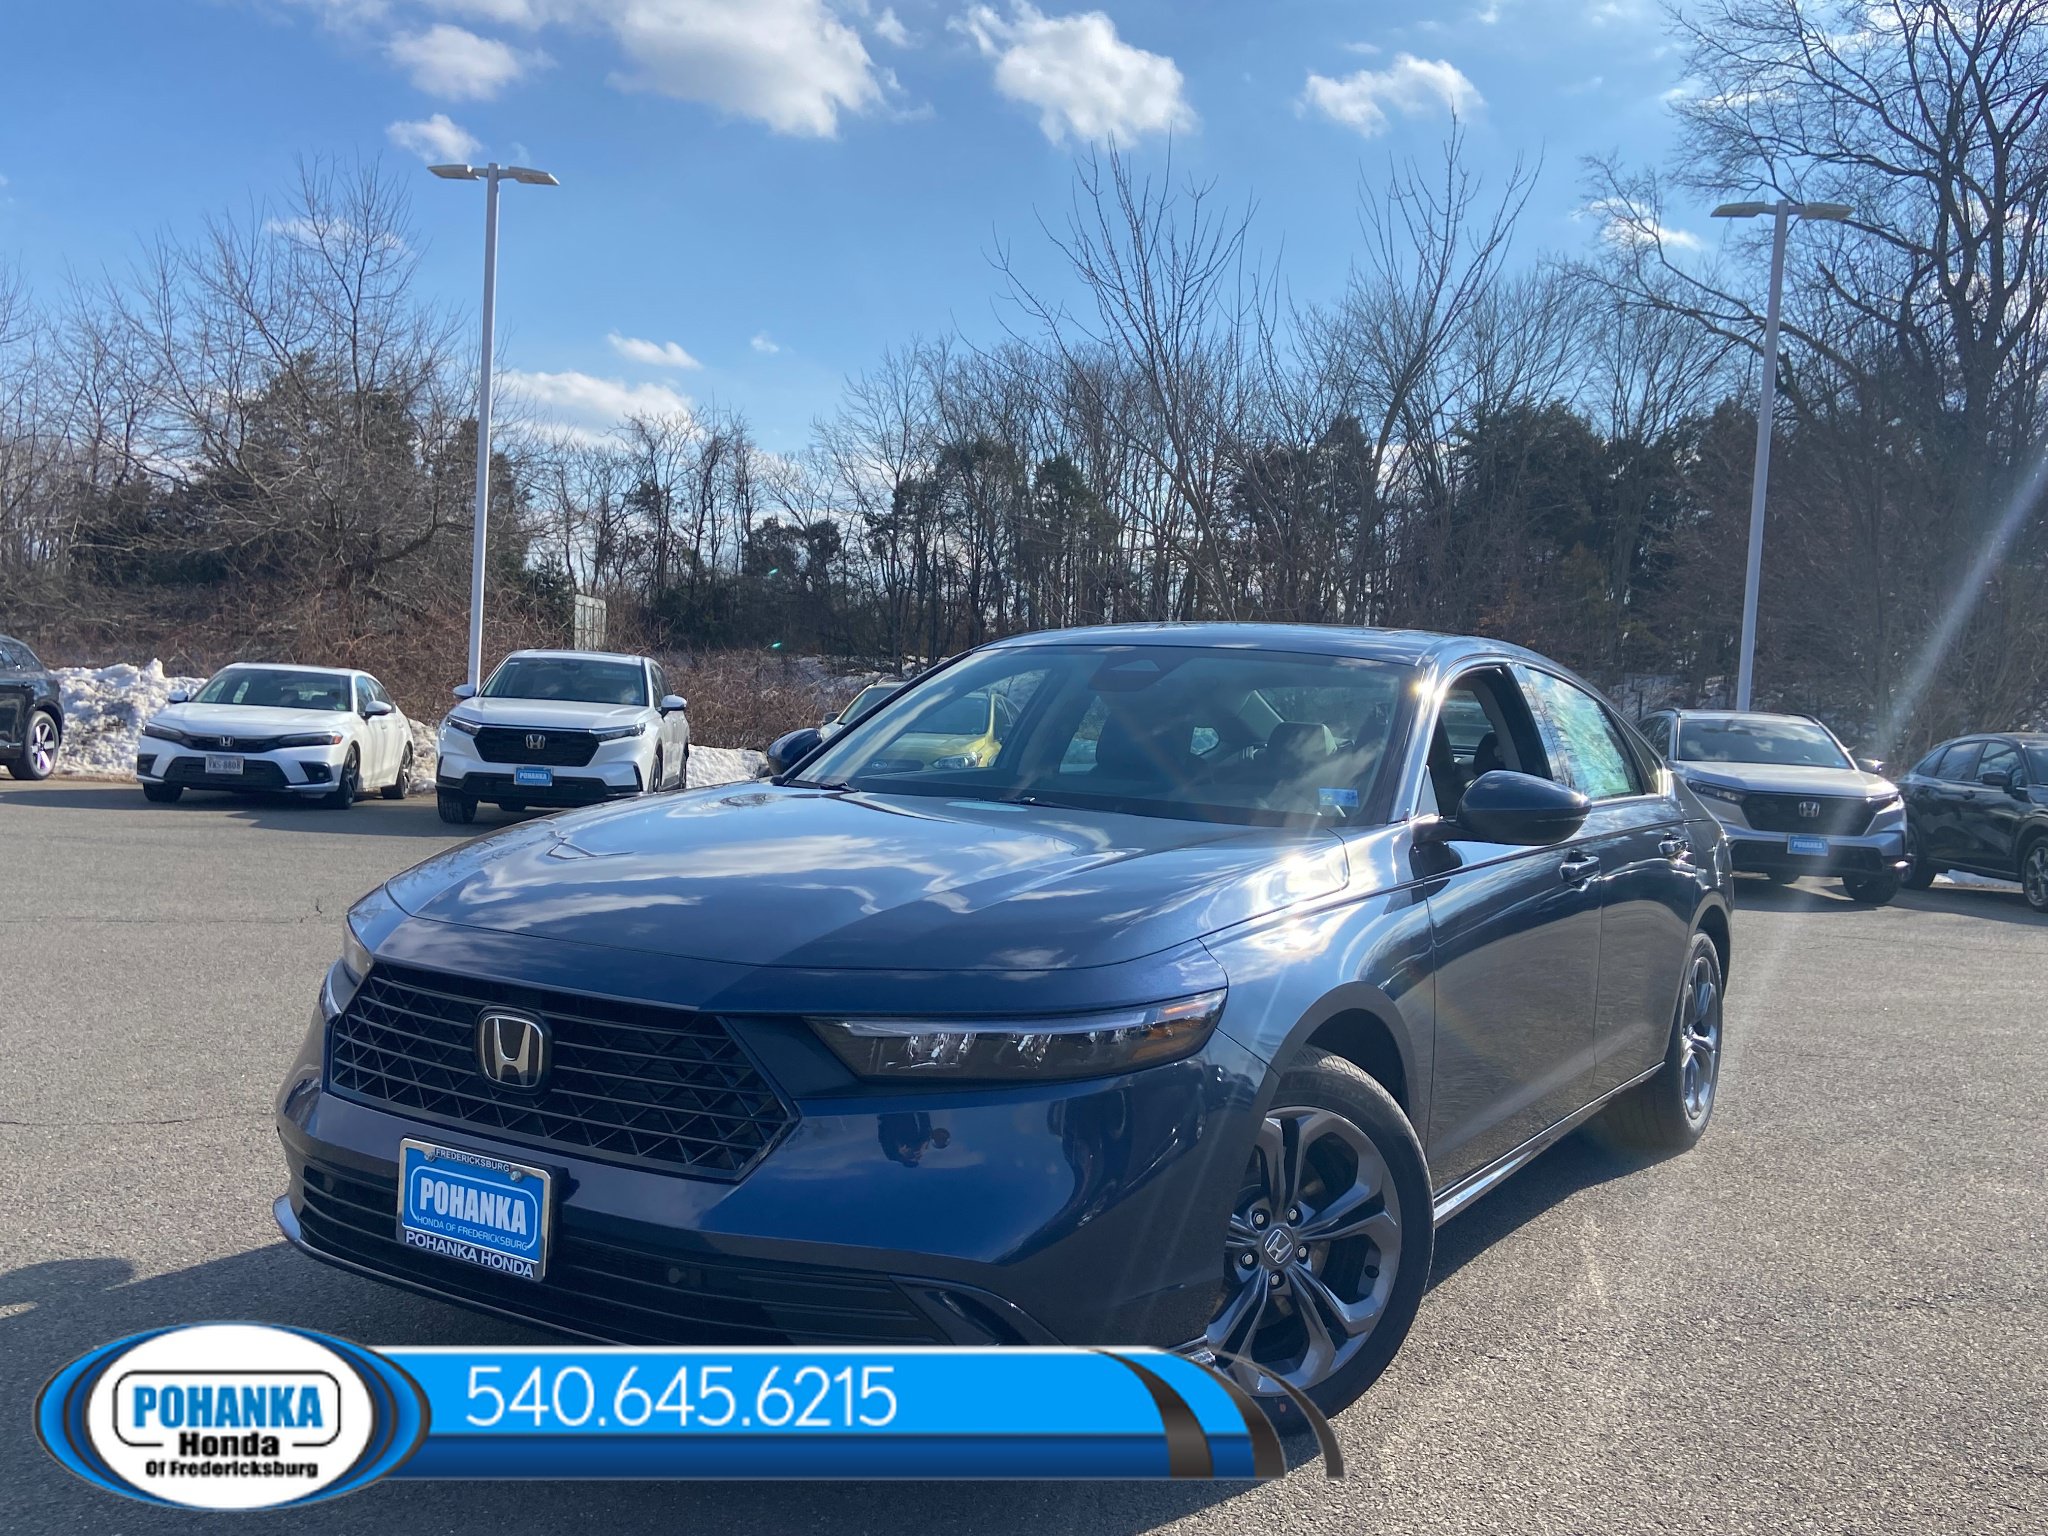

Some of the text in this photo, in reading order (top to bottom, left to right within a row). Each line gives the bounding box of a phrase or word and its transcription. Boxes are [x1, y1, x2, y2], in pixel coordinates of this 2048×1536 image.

[435, 1148, 510, 1172] FREDERICKSBURG
[419, 1176, 527, 1236] POHANKA
[405, 1230, 534, 1278] POHANKA HONDA
[417, 1216, 529, 1251] HONDA OF FREDERICKSBURG
